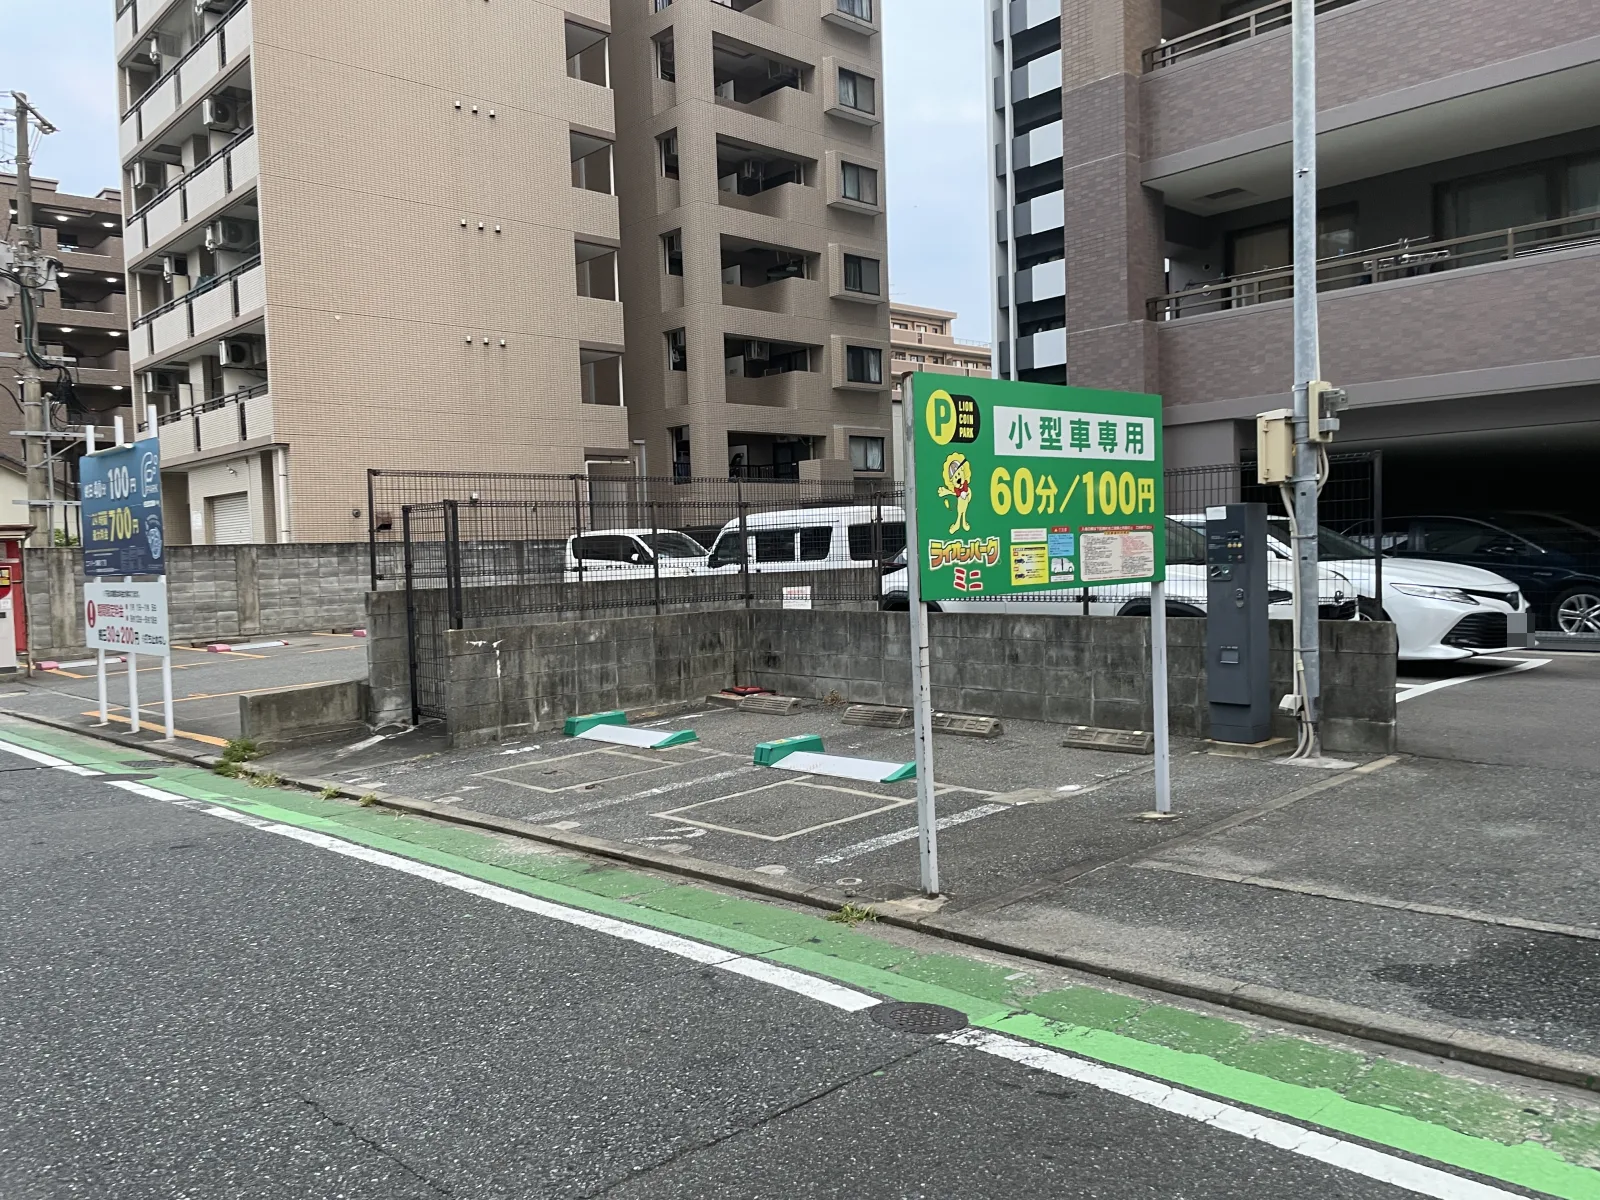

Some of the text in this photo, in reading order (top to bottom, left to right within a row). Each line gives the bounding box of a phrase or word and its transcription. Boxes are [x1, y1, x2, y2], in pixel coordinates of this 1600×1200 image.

[934, 398, 951, 436] P
[958, 401, 974, 411] LION
[959, 413, 974, 425] COIN
[959, 427, 974, 438] PARK
[1008, 414, 1144, 455] 小型車専用
[929, 537, 1000, 569] ライオンパーク
[954, 567, 983, 591] ミニ
